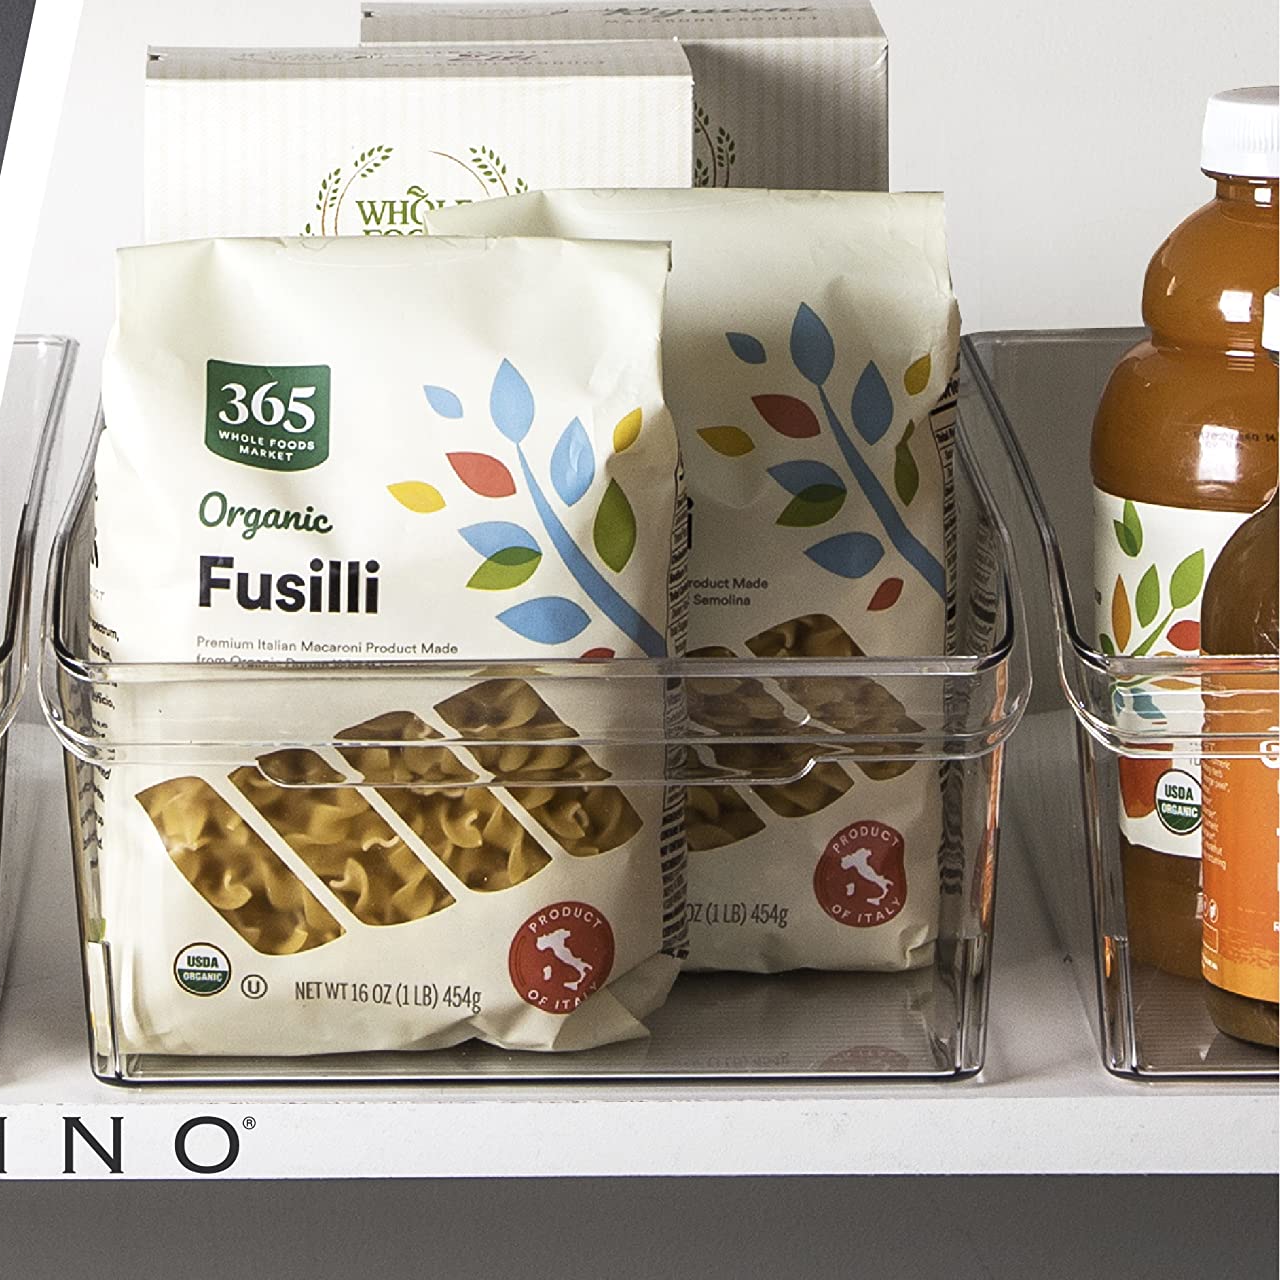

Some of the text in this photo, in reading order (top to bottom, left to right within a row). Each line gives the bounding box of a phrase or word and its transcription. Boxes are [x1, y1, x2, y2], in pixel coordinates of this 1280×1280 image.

[355, 199, 474, 225] WHO
[218, 380, 317, 433] 365
[218, 430, 315, 450] WHOLE FOODS
[239, 445, 294, 462] MARKET
[198, 491, 334, 540] Organic
[197, 554, 380, 614] Fusilli
[687, 577, 769, 589] roduct Made
[692, 593, 752, 606] Semolina
[196, 636, 459, 655] Premium Italian Macaroni Product Made
[1164, 783, 1194, 801] USDA
[1161, 803, 1199, 818] ORGANIC
[832, 825, 900, 854] PRODUCT
[528, 906, 603, 934] PRODUCT
[706, 902, 719, 926] (1
[723, 902, 748, 926] LB)
[750, 903, 790, 929] 454g
[831, 896, 901, 924] OF ITALY
[186, 955, 220, 968] USDA
[182, 971, 223, 983] ORGANIC
[294, 981, 482, 1015] NET WT 16 OZ (1 LB) 454g
[527, 989, 548, 1005] OF
